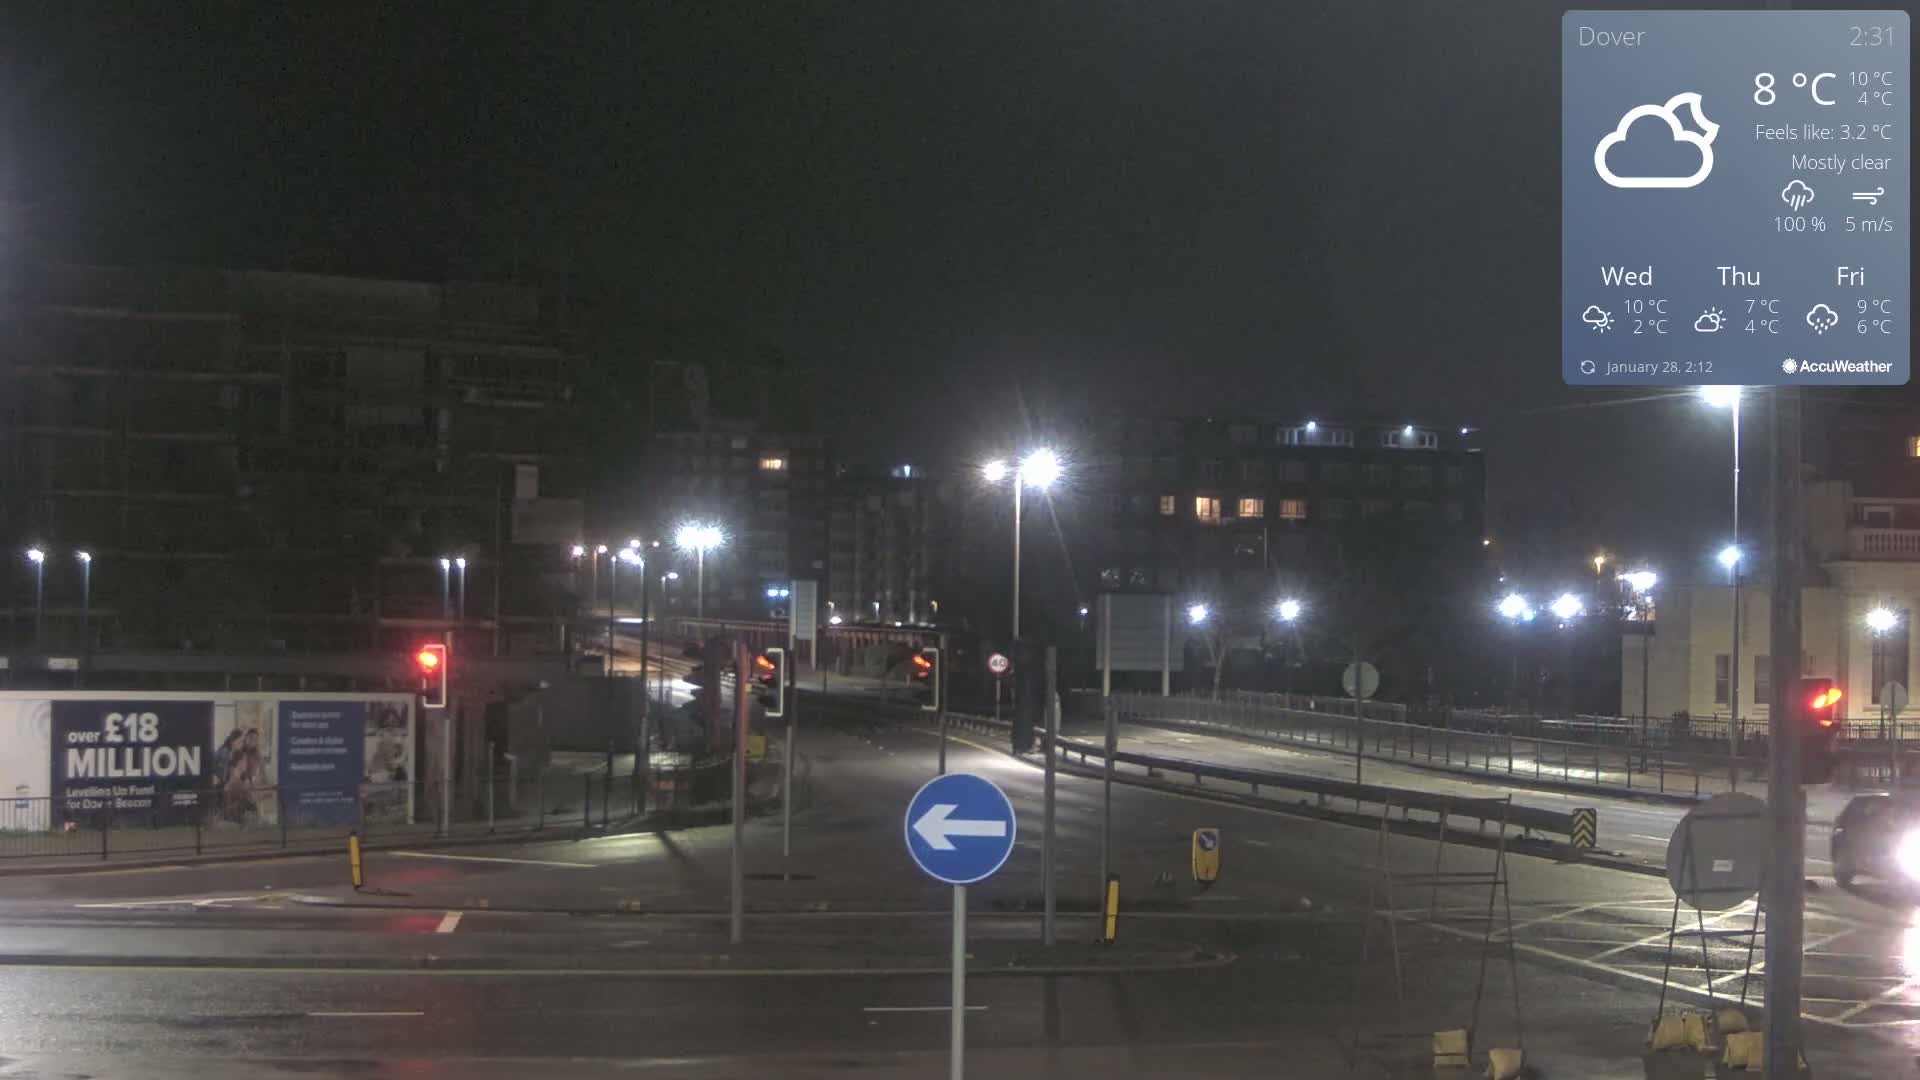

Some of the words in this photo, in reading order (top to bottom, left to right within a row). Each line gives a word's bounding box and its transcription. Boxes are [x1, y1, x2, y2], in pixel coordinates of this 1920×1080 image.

[992, 659, 1006, 667] 40
[67, 731, 101, 743] over
[105, 712, 159, 743] £18
[67, 746, 201, 778] MILLION
